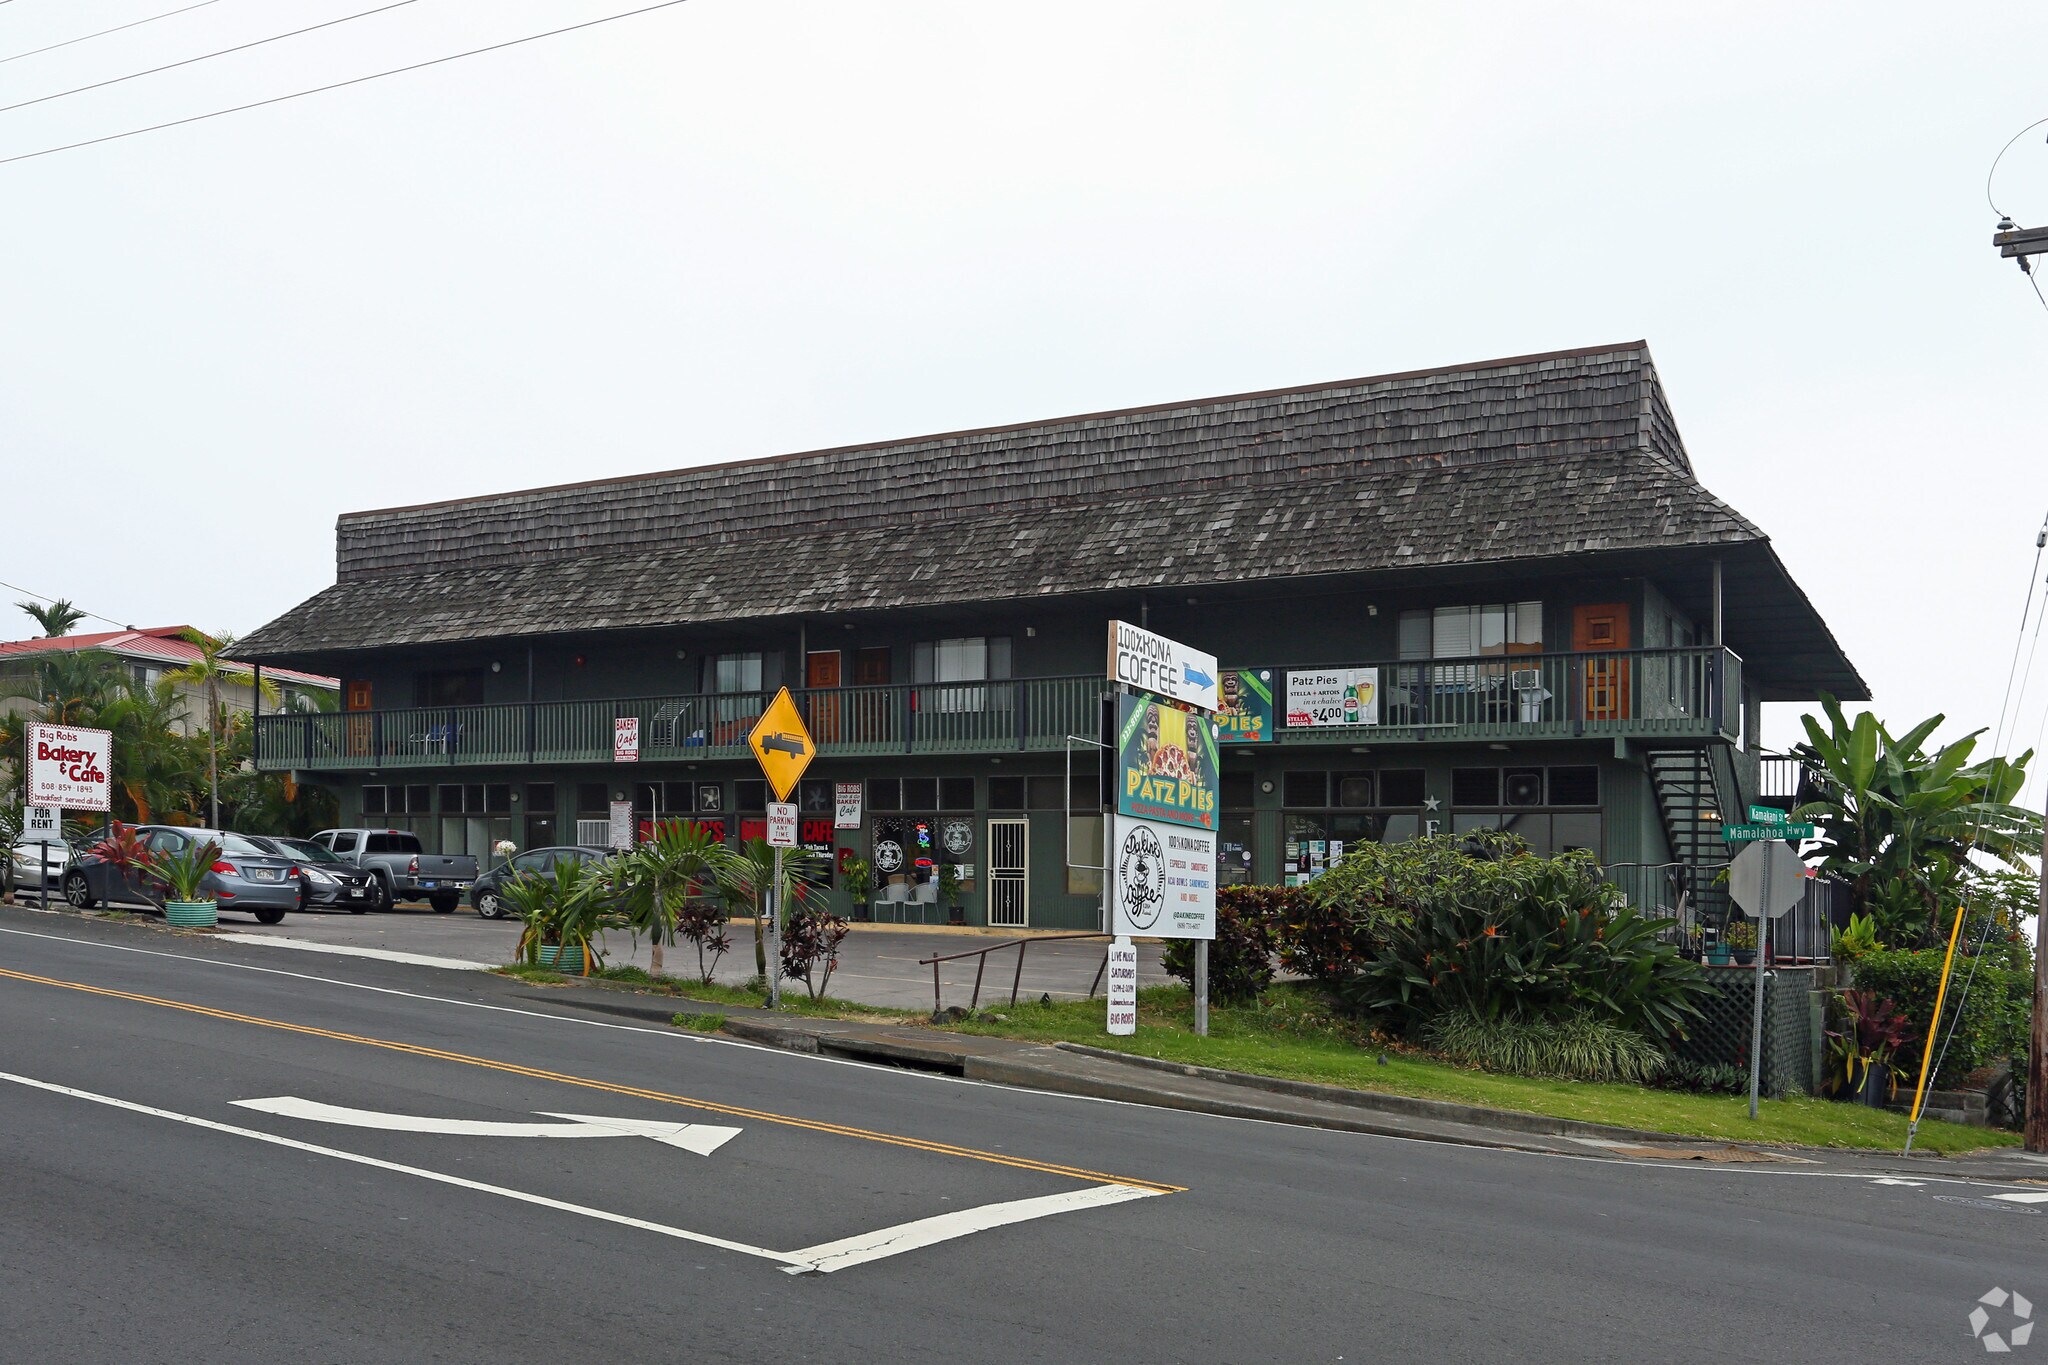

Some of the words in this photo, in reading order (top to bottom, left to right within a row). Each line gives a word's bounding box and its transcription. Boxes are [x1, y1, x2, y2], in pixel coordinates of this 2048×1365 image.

[1118, 651, 1177, 696] COFFEE
[1292, 677, 1314, 686] Patz
[1317, 675, 1338, 685] Pies
[617, 719, 638, 731] BAKERY
[1212, 714, 1263, 731] PIES
[40, 729, 54, 743] Big
[56, 731, 78, 742] Rob's
[616, 731, 638, 750] Cafe
[38, 742, 97, 769] Bakery
[60, 762, 67, 775] &
[69, 764, 105, 783] Cafe
[1127, 767, 1176, 806] PATZ
[1179, 781, 1214, 812] PIES
[34, 793, 62, 802] breakfast
[65, 796, 86, 805] served
[93, 798, 104, 807] day
[34, 808, 51, 818] FOR
[777, 806, 788, 816] NO
[31, 819, 54, 829] RENT
[770, 815, 795, 825] PARKING
[803, 820, 834, 842] CAFE
[1786, 825, 1806, 836] Hwy
[1111, 951, 1122, 962] LIVE
[1123, 950, 1135, 962] MUSIC
[1111, 967, 1135, 979] SATURDAYS
[1110, 1012, 1121, 1025] BIG
